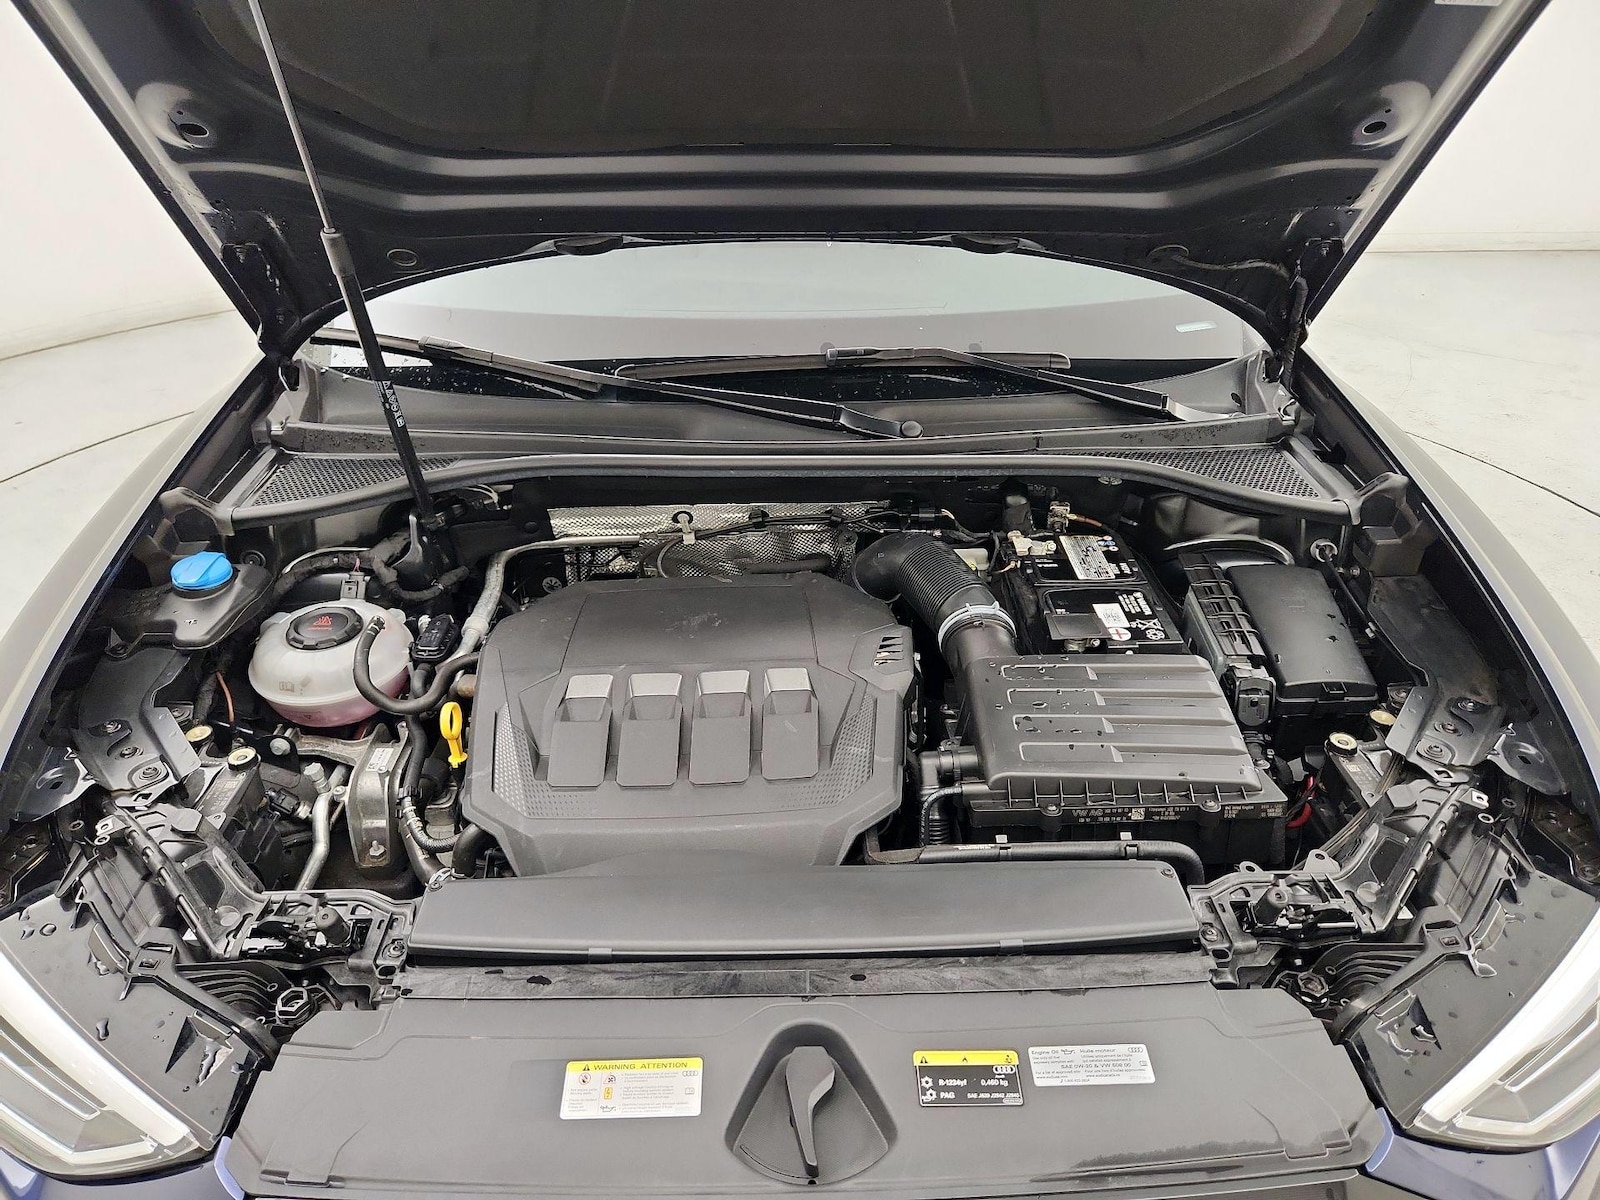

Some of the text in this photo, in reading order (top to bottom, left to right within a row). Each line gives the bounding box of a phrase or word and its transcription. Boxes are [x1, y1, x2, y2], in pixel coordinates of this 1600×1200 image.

[1072, 809, 1088, 817] VW
[640, 1062, 688, 1070] ATTENTION
[999, 1079, 1009, 1087] kg
[940, 1091, 956, 1099] PAG
